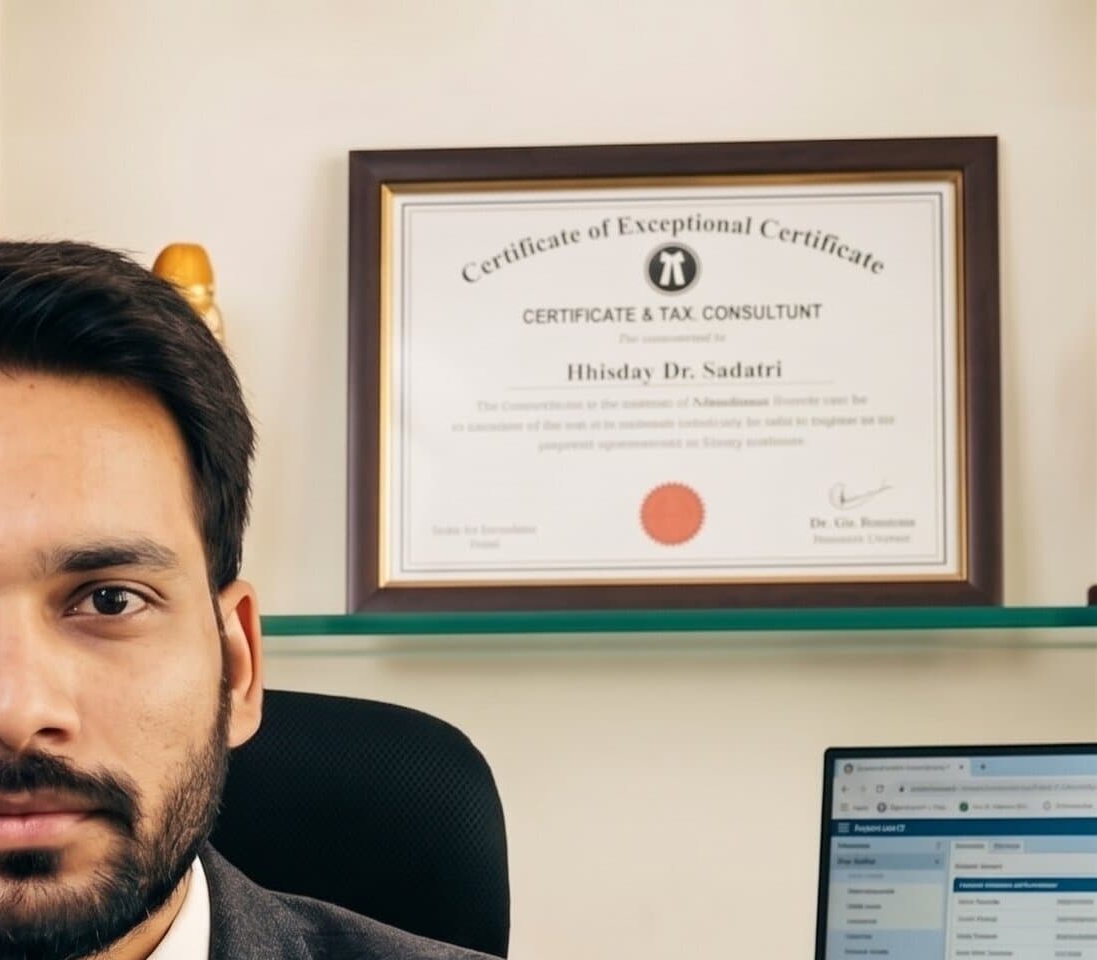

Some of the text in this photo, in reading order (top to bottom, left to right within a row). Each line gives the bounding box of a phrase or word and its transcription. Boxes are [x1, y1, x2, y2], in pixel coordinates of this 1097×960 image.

[462, 213, 885, 283] Certificate of Exceptional Certificate
[522, 306, 637, 324] CERTIFICATE
[641, 307, 653, 322] &
[702, 303, 822, 320] CONSULTUNT
[567, 360, 782, 385] Hhisday Dr. Sadatri
